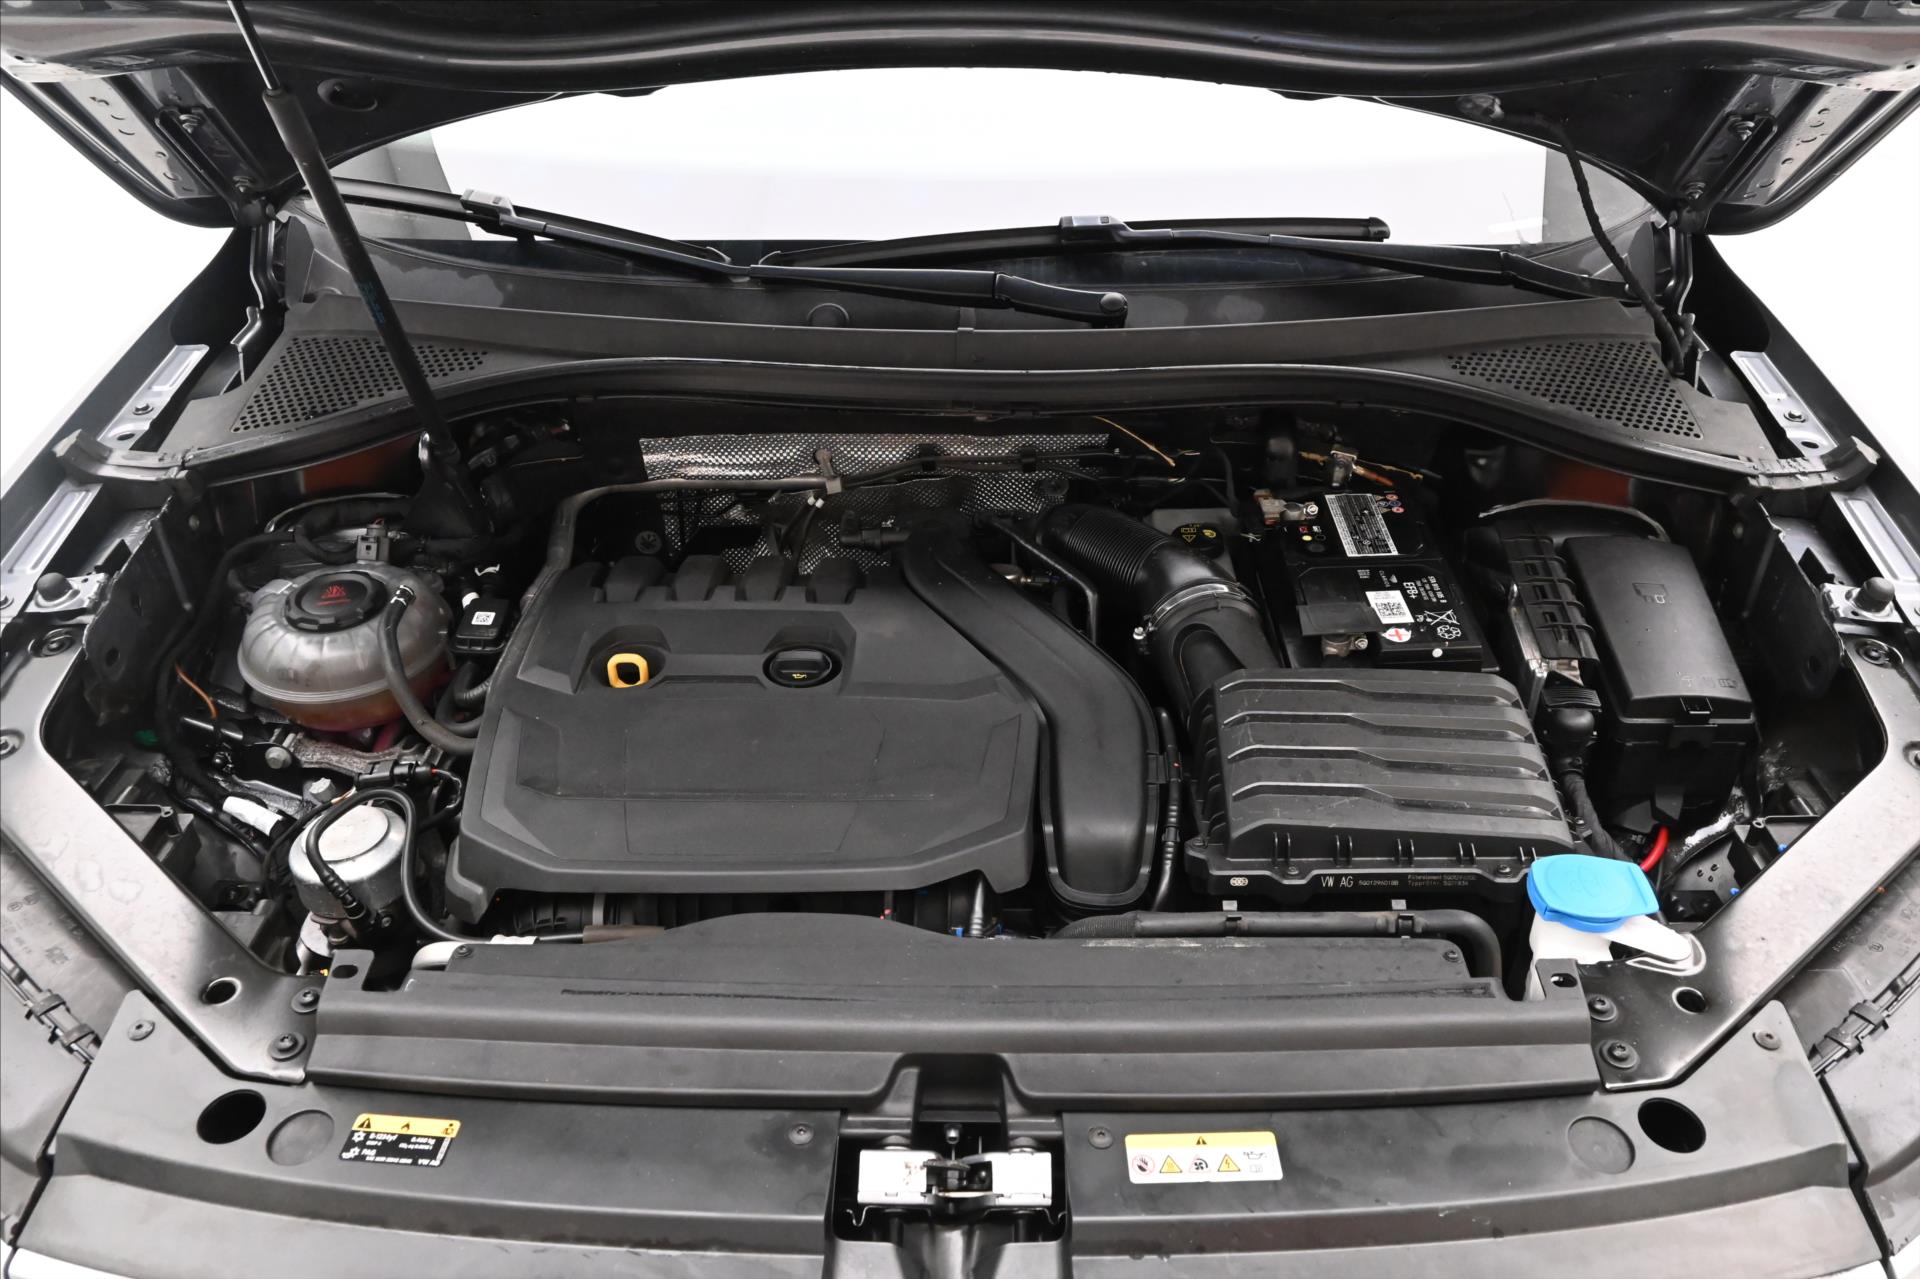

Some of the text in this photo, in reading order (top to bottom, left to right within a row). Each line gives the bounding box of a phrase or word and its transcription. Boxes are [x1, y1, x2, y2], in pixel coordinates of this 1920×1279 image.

[1403, 581, 1418, 599] EFB+
[1320, 875, 1354, 888] VW AG
[417, 1158, 429, 1166] VW
